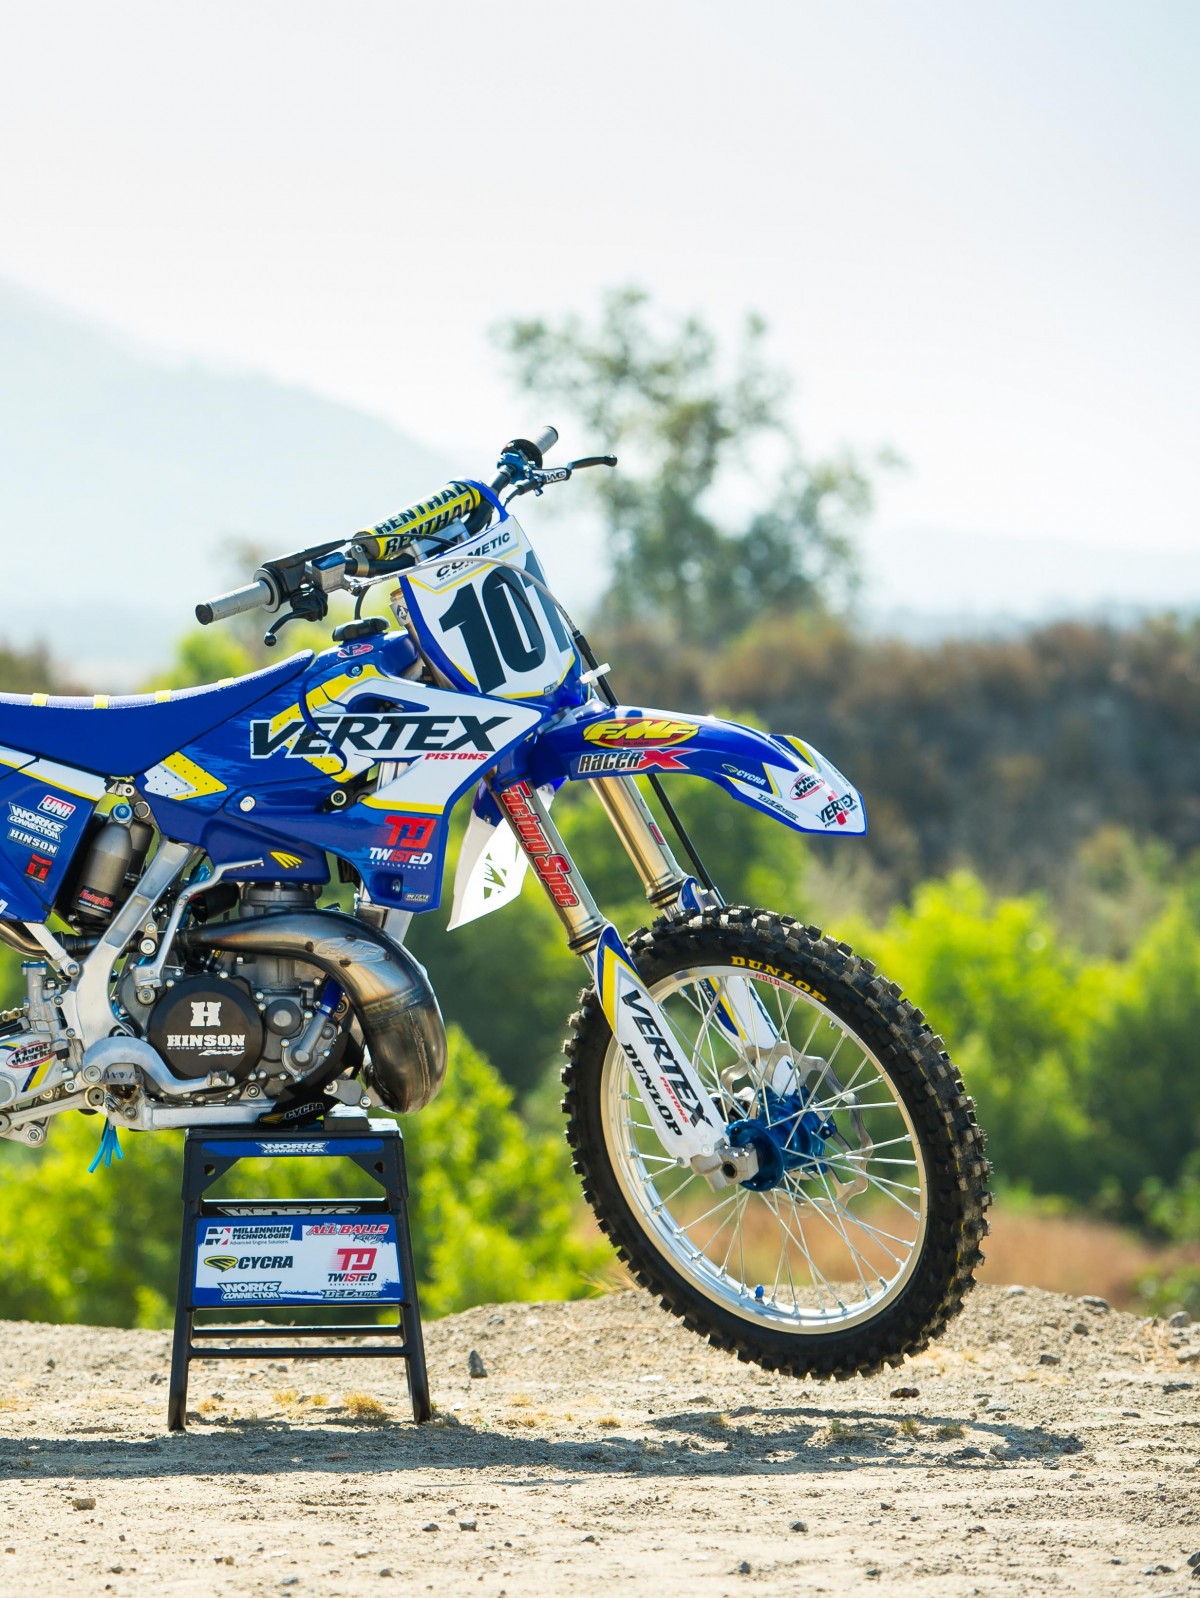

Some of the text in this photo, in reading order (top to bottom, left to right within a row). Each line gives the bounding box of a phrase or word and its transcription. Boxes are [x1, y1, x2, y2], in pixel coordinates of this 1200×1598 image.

[374, 484, 469, 535] RENTHAL
[384, 498, 472, 556] RENTHAL
[438, 550, 571, 694] 101
[252, 715, 512, 757] VERTEX
[584, 720, 700, 741] FMF
[425, 752, 488, 761] PISTONS
[736, 769, 767, 786] CYCRA
[10, 804, 65, 832] WORKS
[41, 796, 75, 819] UNI
[816, 792, 857, 823] VERTEX
[8, 814, 60, 841] CONNECTION
[9, 828, 58, 854] HINSON
[369, 847, 433, 865] TWISTED
[534, 854, 580, 907] Spec
[731, 955, 828, 1003] DUNLOP
[190, 1001, 222, 1027] H
[166, 1034, 246, 1047] HINSON
[621, 989, 714, 1128] VERTEX
[621, 1042, 682, 1136] DUNLOP
[660, 1075, 689, 1124] PISTONS
[284, 1102, 325, 1120] CYCRA
[232, 1226, 292, 1234] MILLENNIUM
[306, 1225, 337, 1236] ALL
[339, 1224, 389, 1235] BALLS
[237, 1255, 294, 1270] CYCRA
[220, 1282, 279, 1293] WORKS
[327, 1273, 378, 1283] TWISTED
[222, 1291, 279, 1300] CONNECTION
